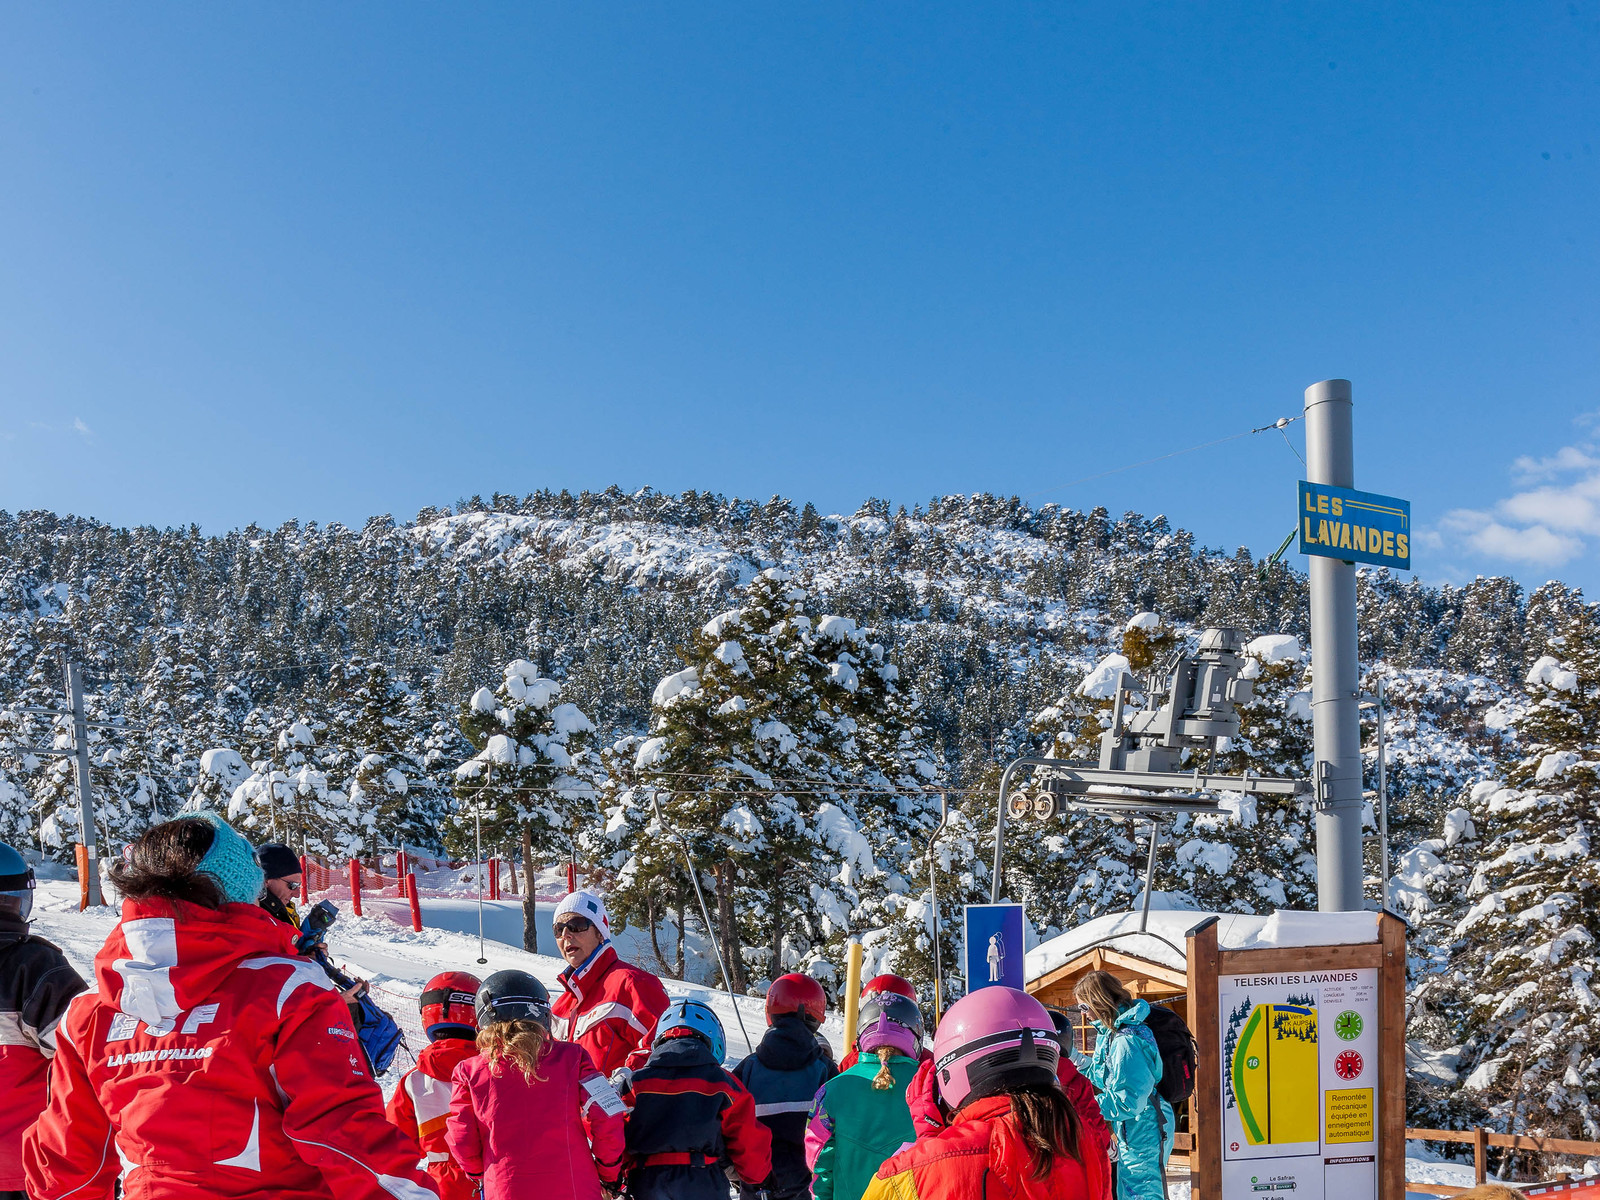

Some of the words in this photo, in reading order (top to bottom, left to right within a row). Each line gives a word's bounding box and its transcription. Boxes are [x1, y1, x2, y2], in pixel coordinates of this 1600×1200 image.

[1306, 492, 1343, 517] LES
[1304, 517, 1409, 559] LAVANDES
[1234, 976, 1278, 987] TELESKI
[1281, 975, 1300, 985] LES
[1303, 972, 1358, 984] LAVANDES
[107, 1055, 124, 1067] LA
[123, 1050, 159, 1064] FOUX
[158, 1046, 213, 1061] D'ALLOS
[1248, 1058, 1258, 1067] 16
[1331, 1094, 1367, 1102] Remontée
[1331, 1103, 1368, 1111] mécanique
[1331, 1112, 1358, 1120] équipée
[1328, 1120, 1371, 1129] enneigement
[1329, 1130, 1370, 1138] automatique
[1329, 1156, 1370, 1164] INFORMATIONS
